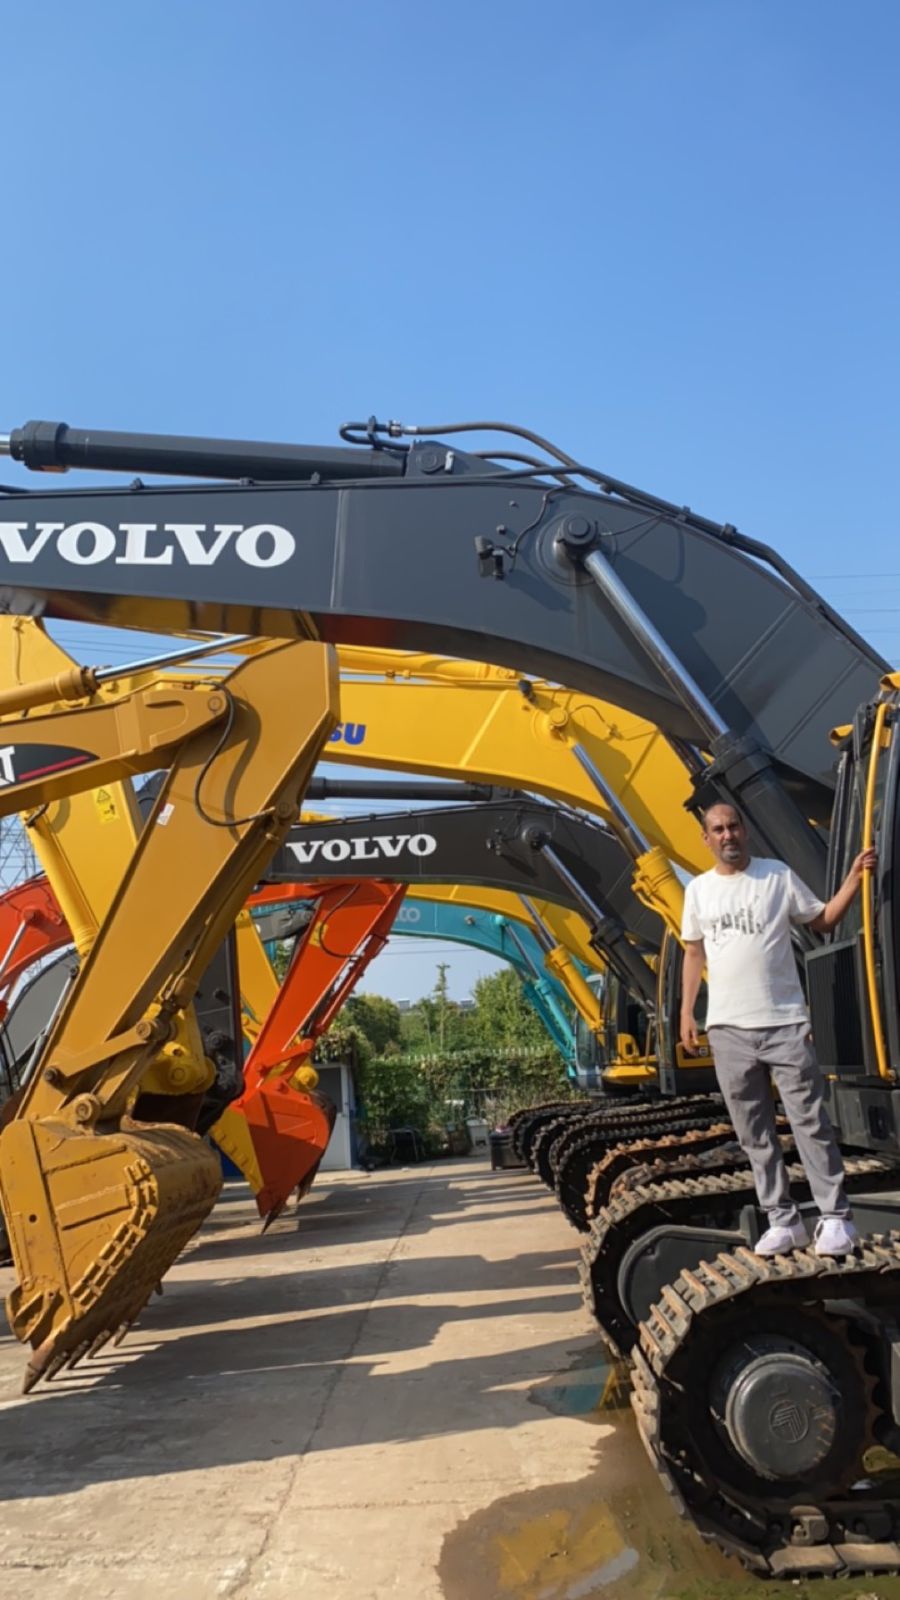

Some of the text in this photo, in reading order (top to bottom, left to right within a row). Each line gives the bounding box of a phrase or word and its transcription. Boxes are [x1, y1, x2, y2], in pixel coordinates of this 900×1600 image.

[0, 521, 297, 569] VOLVO
[0, 745, 16, 786] T
[285, 833, 438, 864] VOLVO
